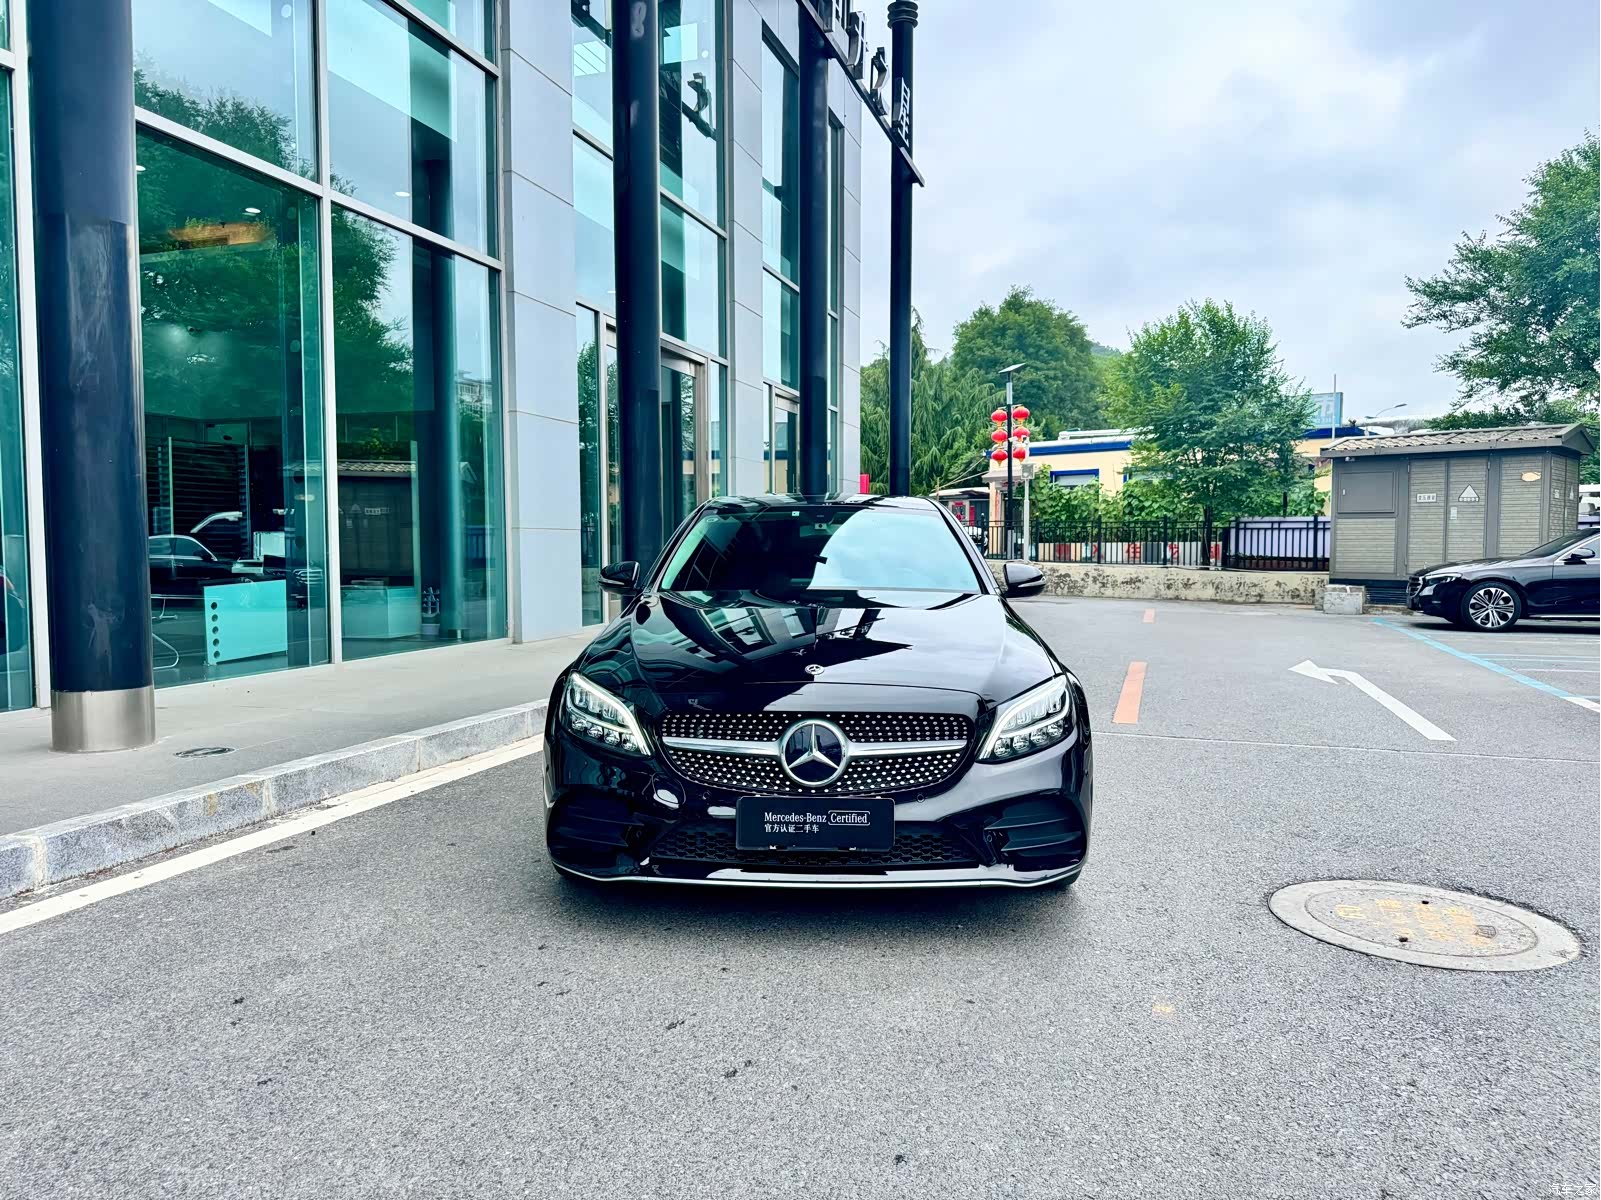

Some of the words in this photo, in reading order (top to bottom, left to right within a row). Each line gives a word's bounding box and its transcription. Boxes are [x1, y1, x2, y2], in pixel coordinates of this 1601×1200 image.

[764, 812, 827, 823] Mercedes-Benz
[830, 813, 868, 824] Certified
[764, 824, 820, 834] 官方认证二手车
